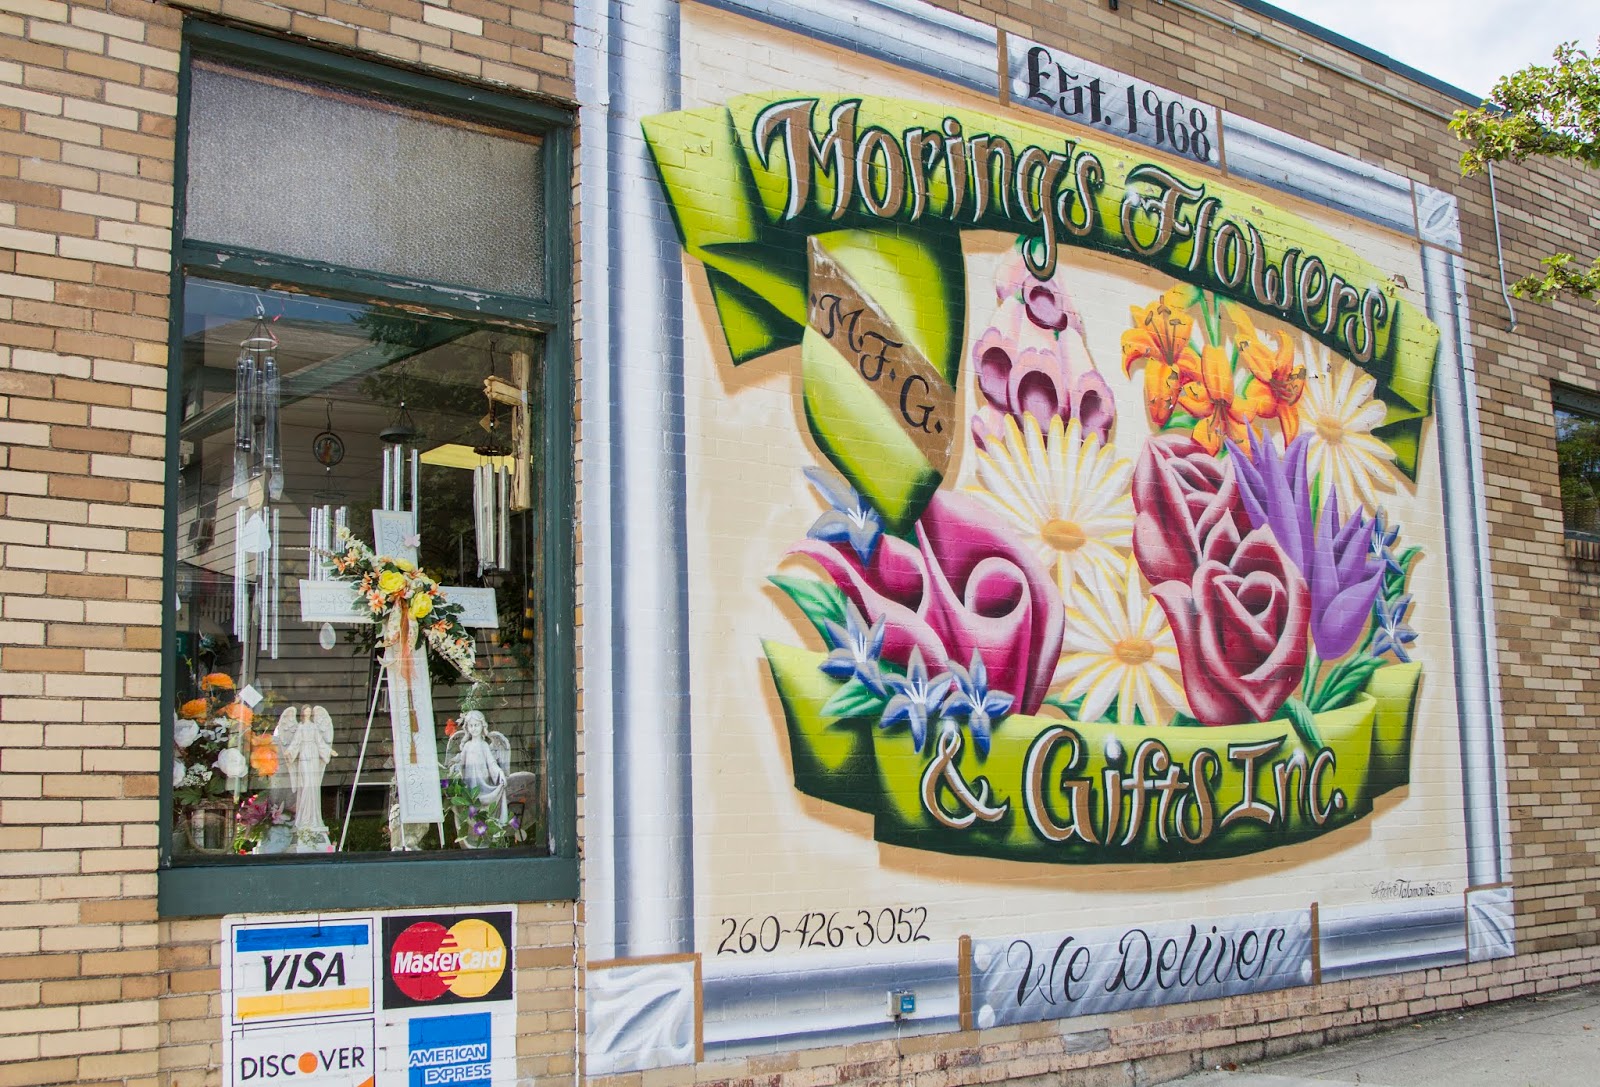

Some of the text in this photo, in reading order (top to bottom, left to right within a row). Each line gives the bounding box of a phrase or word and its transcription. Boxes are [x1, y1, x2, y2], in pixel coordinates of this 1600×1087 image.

[1027, 46, 1210, 163] Est. 1968
[752, 97, 1388, 363] Moring's Flowers
[921, 719, 1346, 847] & Gifts Inc.
[717, 907, 932, 956] 260-426-3052
[262, 951, 346, 991] VISA
[393, 947, 503, 974] MasterCard
[1006, 924, 1289, 1008] We Deliver
[241, 1047, 365, 1081] DISCOVER
[409, 1043, 488, 1066] AMERICAN
[425, 1064, 492, 1085] EXPRESS
